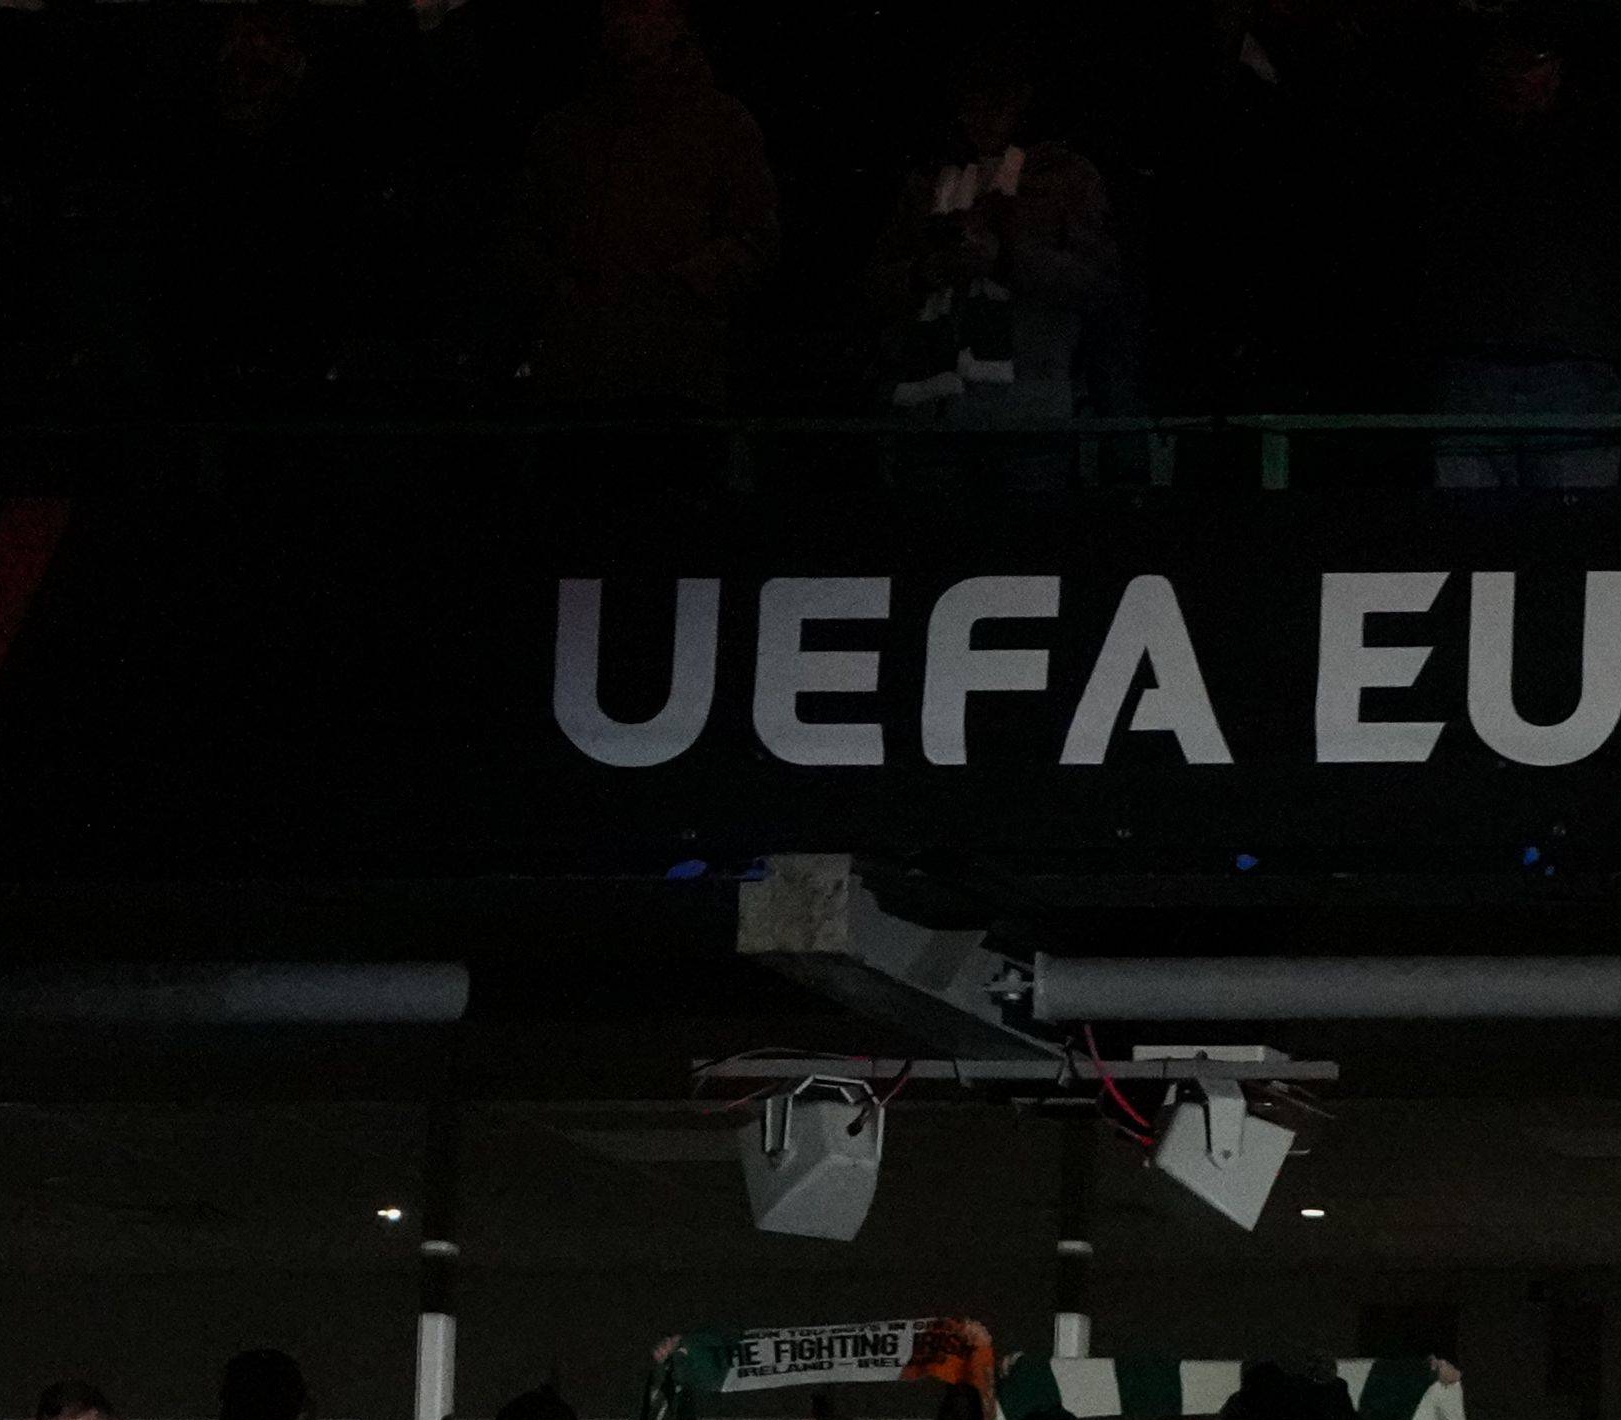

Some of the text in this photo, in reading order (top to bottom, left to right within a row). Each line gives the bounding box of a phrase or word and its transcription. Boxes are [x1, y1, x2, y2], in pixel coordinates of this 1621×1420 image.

[553, 573, 1234, 768] UEFA
[711, 1342, 760, 1366] THE
[776, 1332, 897, 1361] FIGHTING
